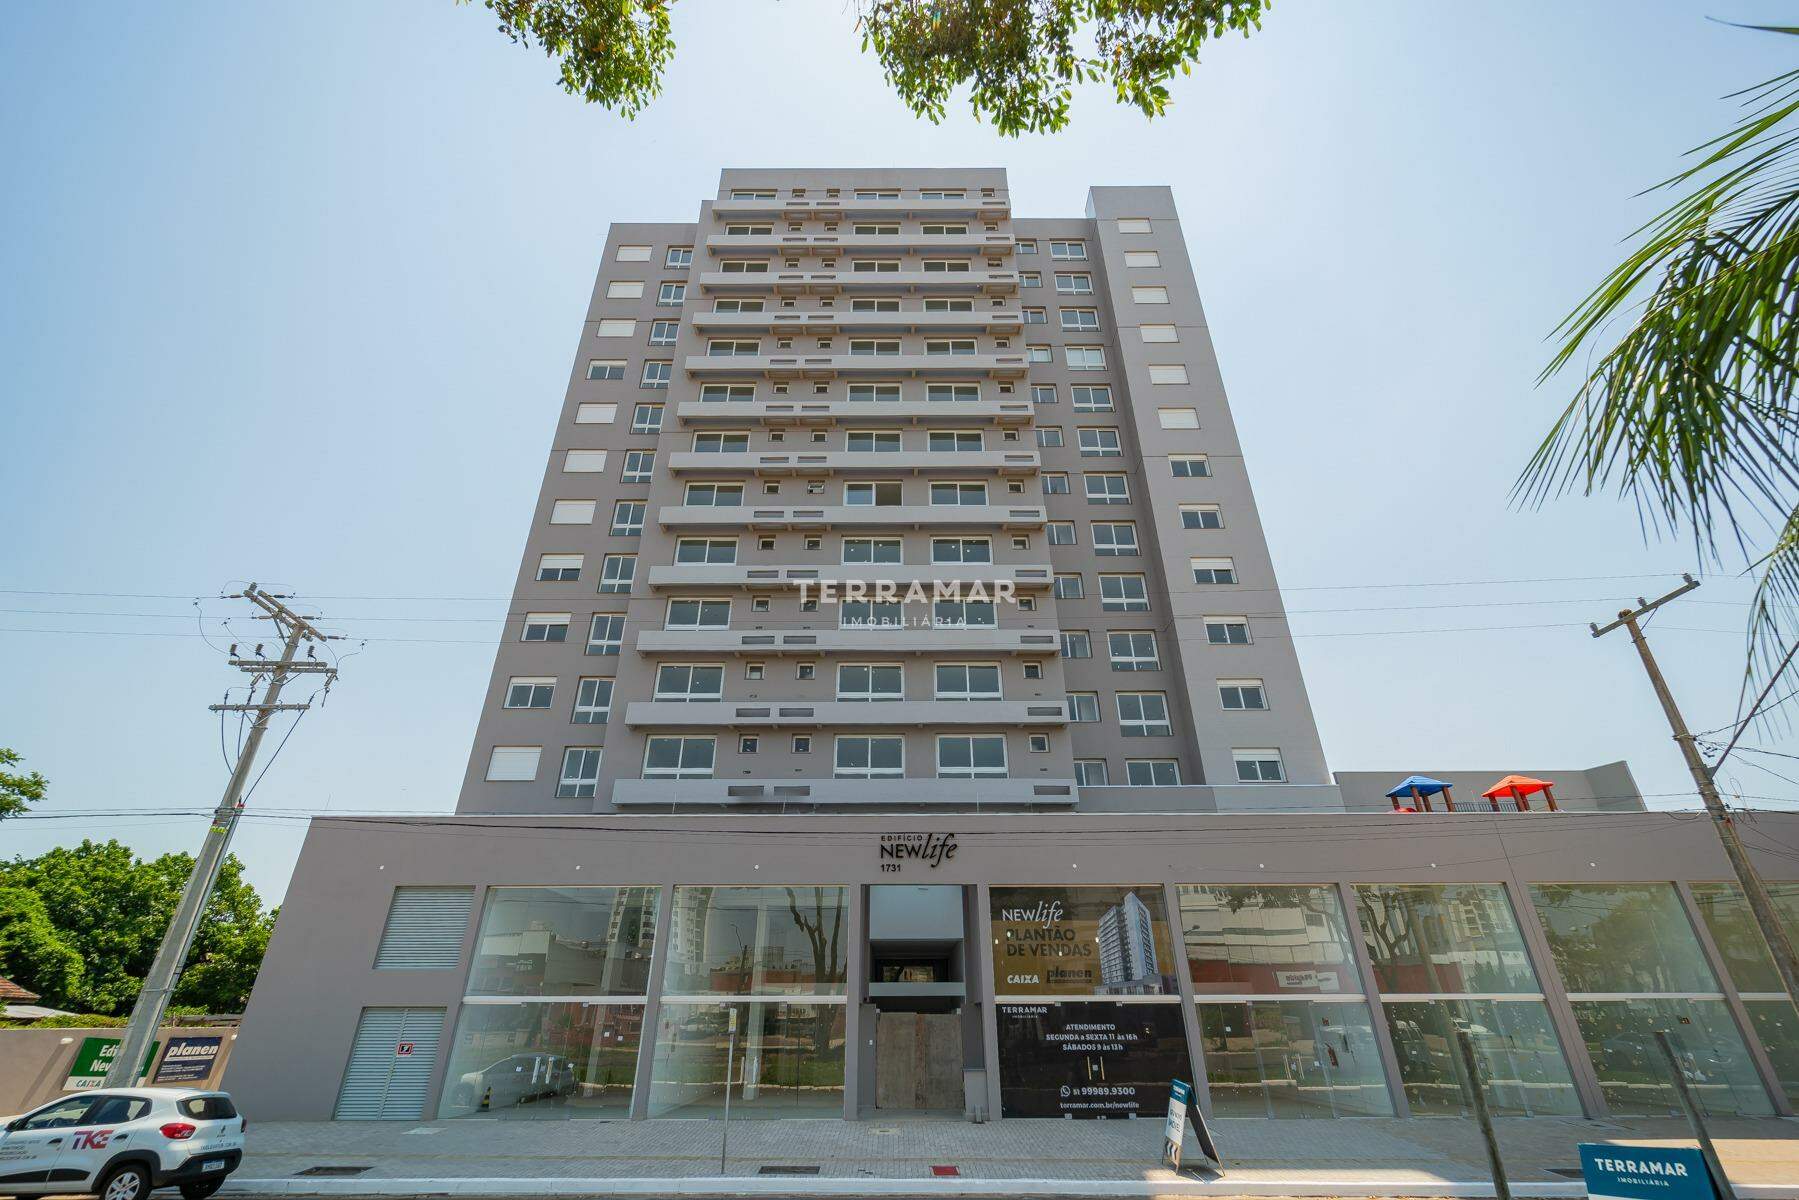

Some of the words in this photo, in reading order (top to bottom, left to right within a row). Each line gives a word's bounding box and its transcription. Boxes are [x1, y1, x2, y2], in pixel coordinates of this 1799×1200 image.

[880, 863, 902, 872] 1731
[1006, 926, 1076, 942] PLANTÃO
[1007, 943, 1026, 957] DE
[1029, 943, 1092, 957] VENDAS
[1007, 974, 1040, 984] CAIXA
[1002, 1006, 1048, 1014] TERRAMAR
[1046, 1033, 1080, 1041] SEGUNDA
[1085, 1033, 1108, 1041] SEXTA
[167, 1042, 220, 1058] planen
[1063, 1042, 1097, 1051] SÁBADOS
[1594, 1158, 1689, 1177] TERRAMAR
